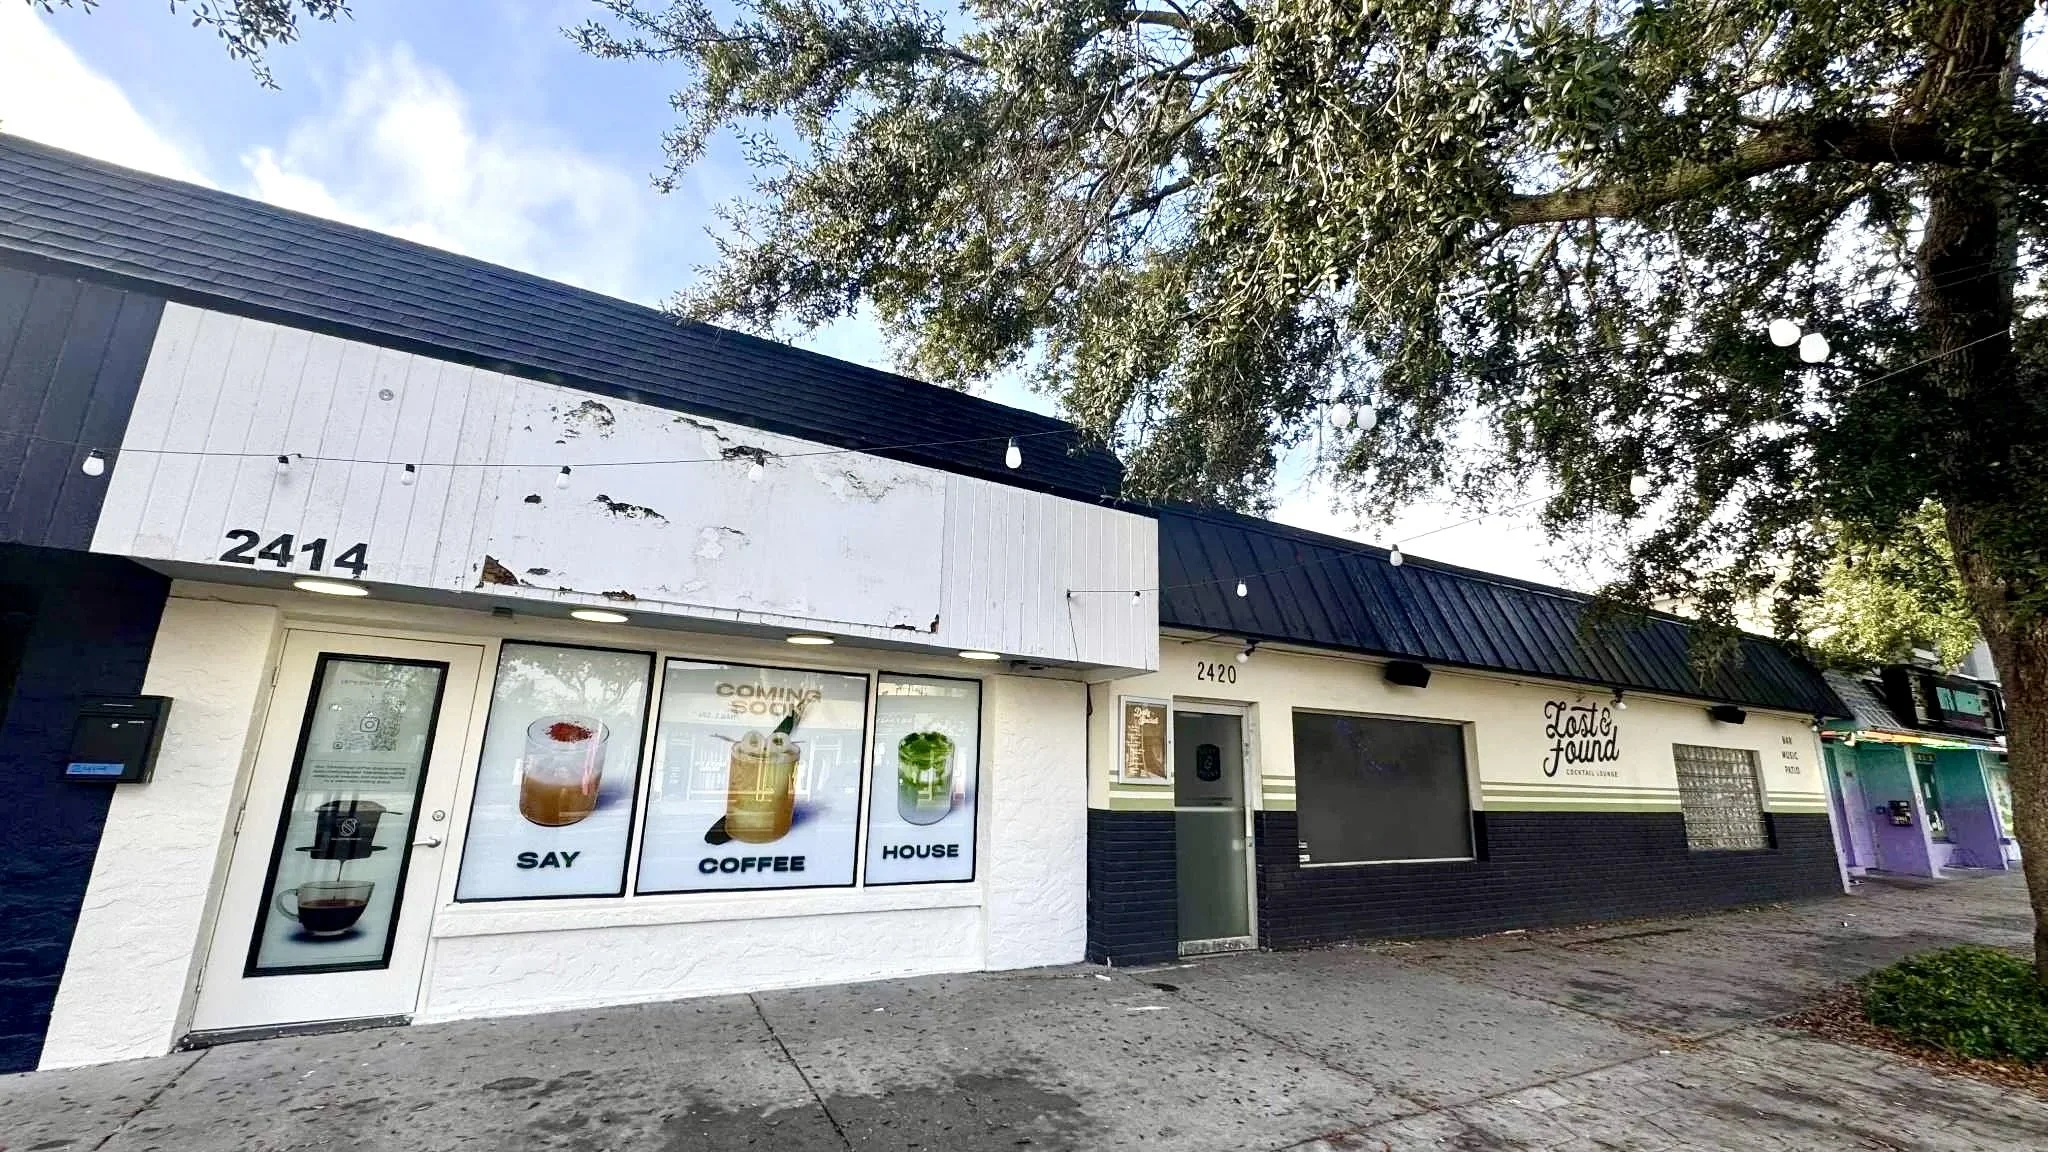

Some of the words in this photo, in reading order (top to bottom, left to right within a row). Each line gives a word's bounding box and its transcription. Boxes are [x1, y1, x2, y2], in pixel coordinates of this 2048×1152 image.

[219, 529, 369, 578] 2414
[1197, 661, 1237, 684] 2420
[715, 682, 823, 703] COMING
[1544, 701, 1598, 738] Lost
[1600, 707, 1612, 736] &
[1543, 726, 1620, 777] Found
[1781, 751, 1799, 760] MUSIC
[1566, 769, 1595, 777] COCKTAIL
[1597, 770, 1619, 778] LOUNGE
[516, 850, 581, 870] SAY
[882, 843, 960, 860] HOUSE
[698, 856, 806, 874] COFFEE
